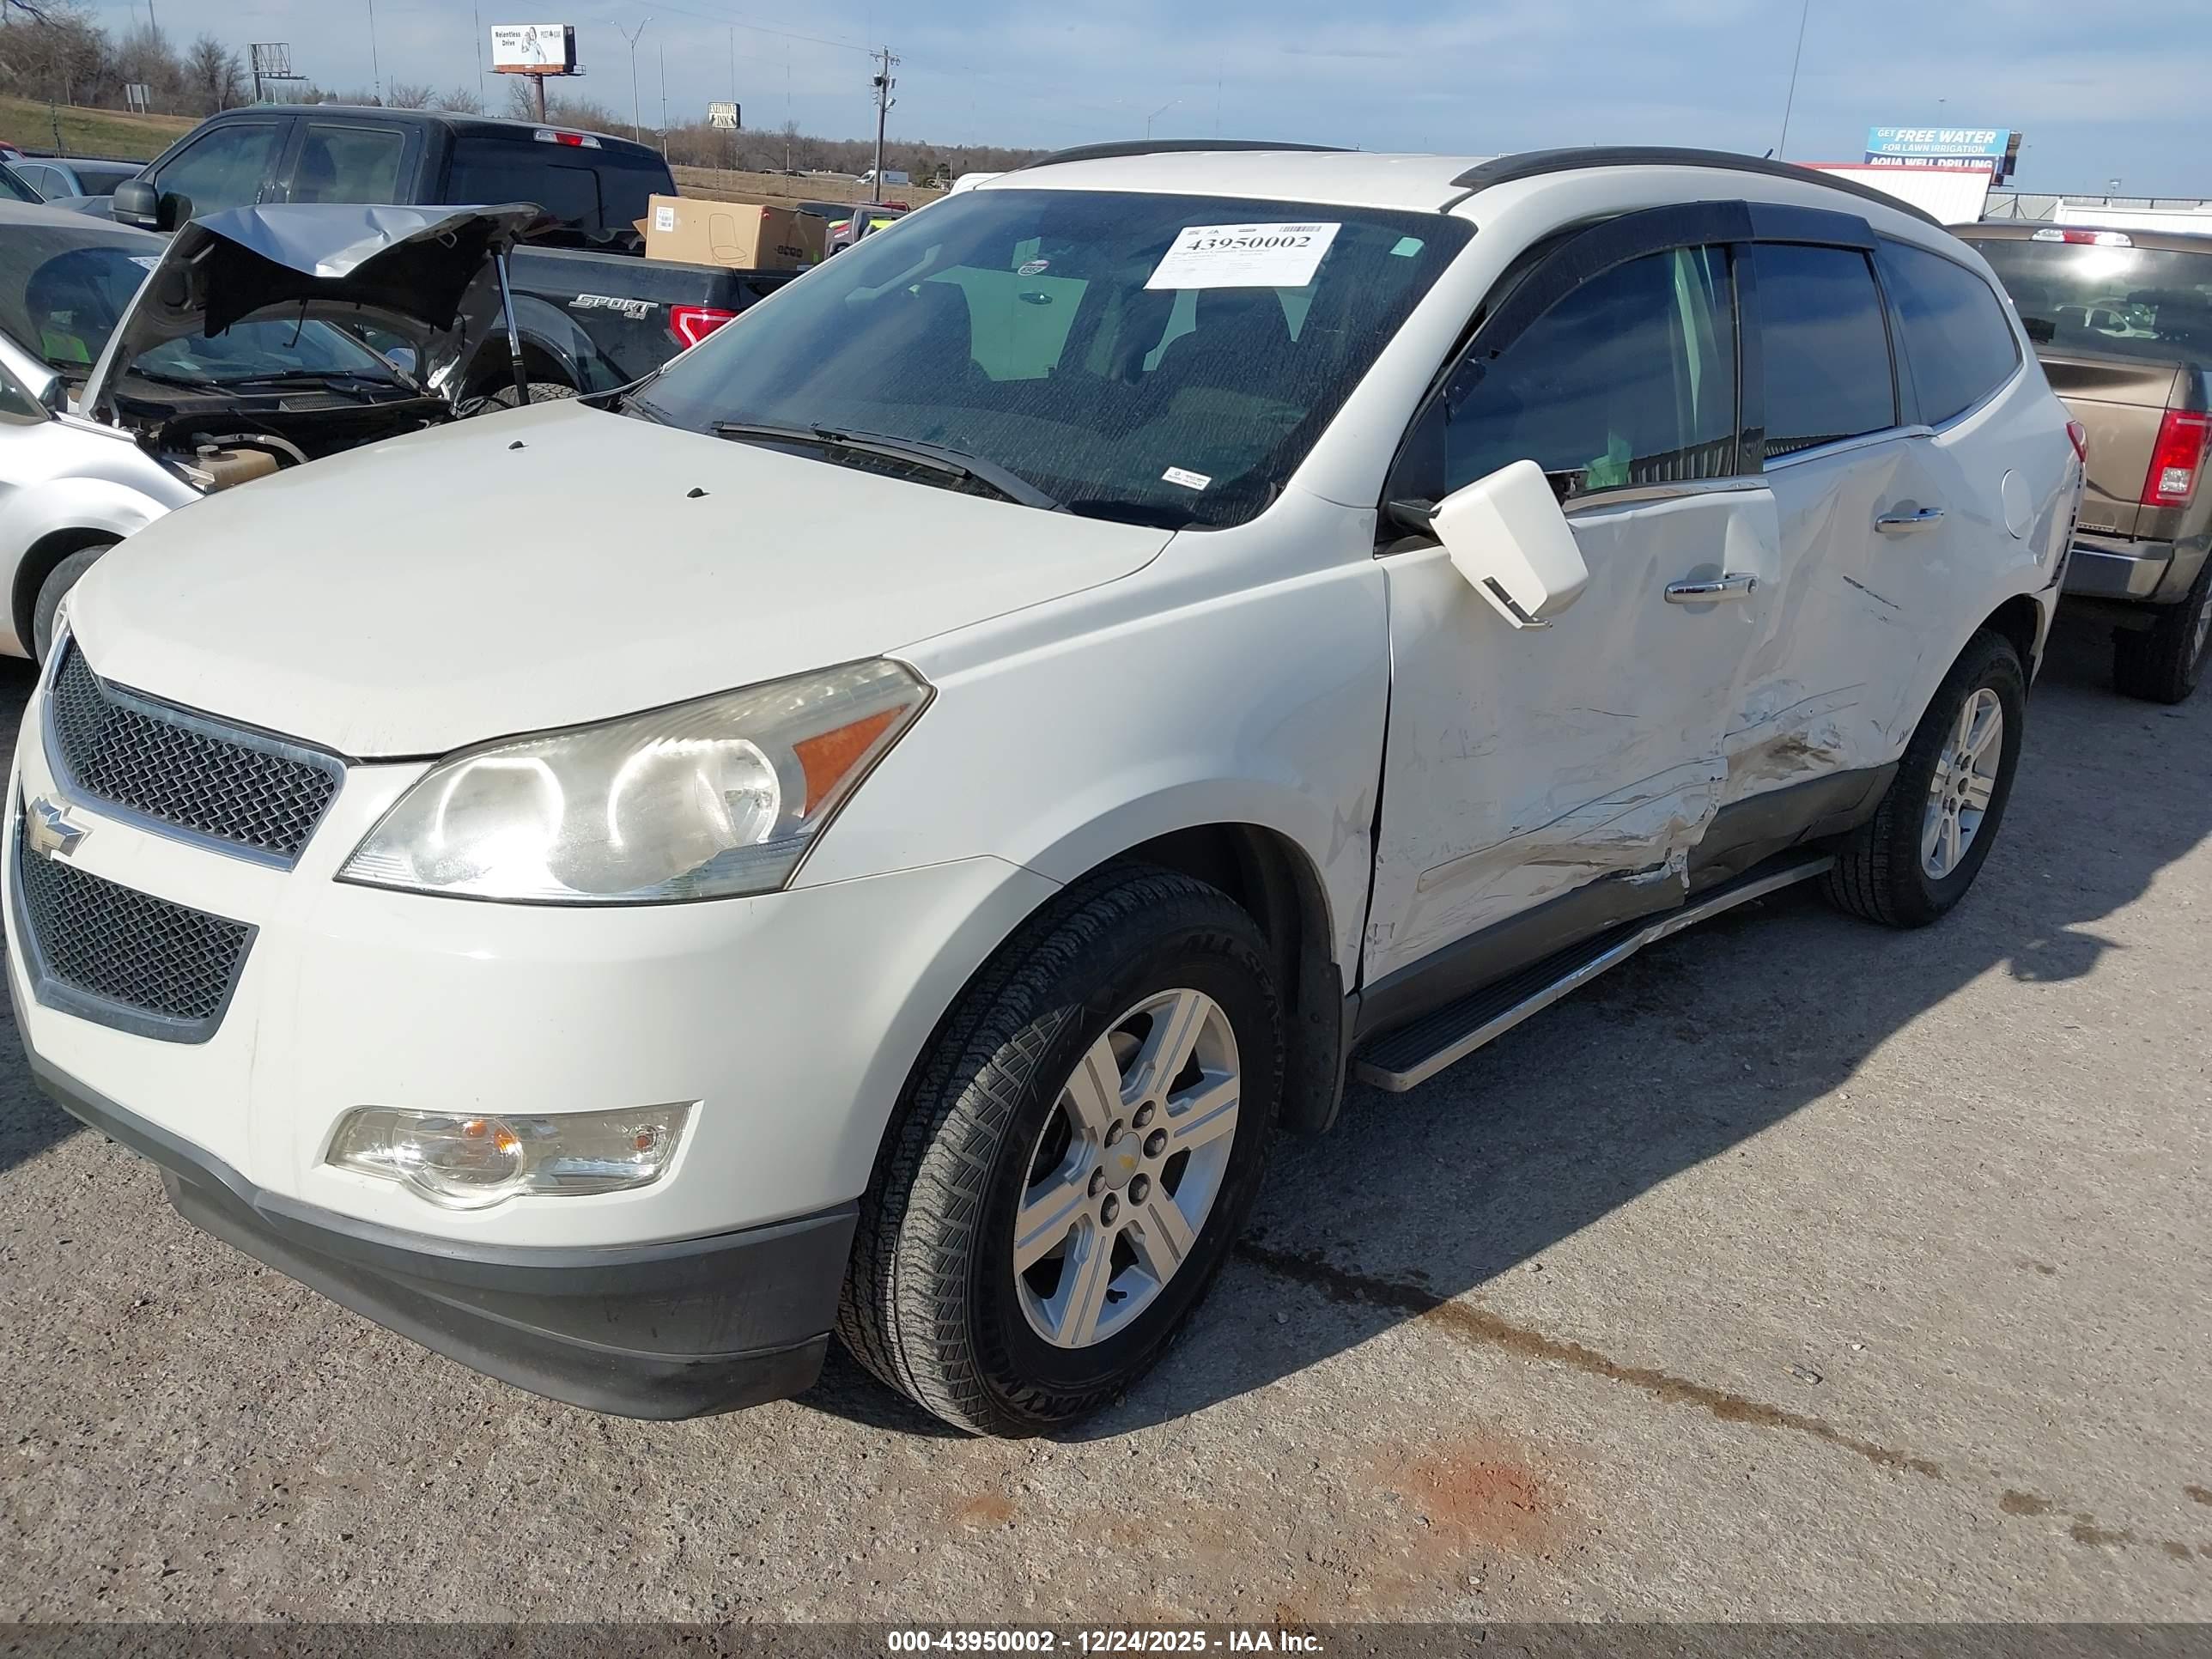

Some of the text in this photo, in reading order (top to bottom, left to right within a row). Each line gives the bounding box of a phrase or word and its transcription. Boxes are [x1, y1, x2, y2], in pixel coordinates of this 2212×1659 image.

[495, 30, 521, 39] Relentless
[710, 103, 736, 114] EXECUTIVE
[717, 115, 731, 127] INN
[1894, 130, 1936, 143] FREE
[1939, 130, 1996, 144] WATER
[1882, 143, 1985, 154] FOR LAWN IRRIGATION
[1186, 235, 1311, 251] 43950002
[568, 294, 659, 314] SPORT
